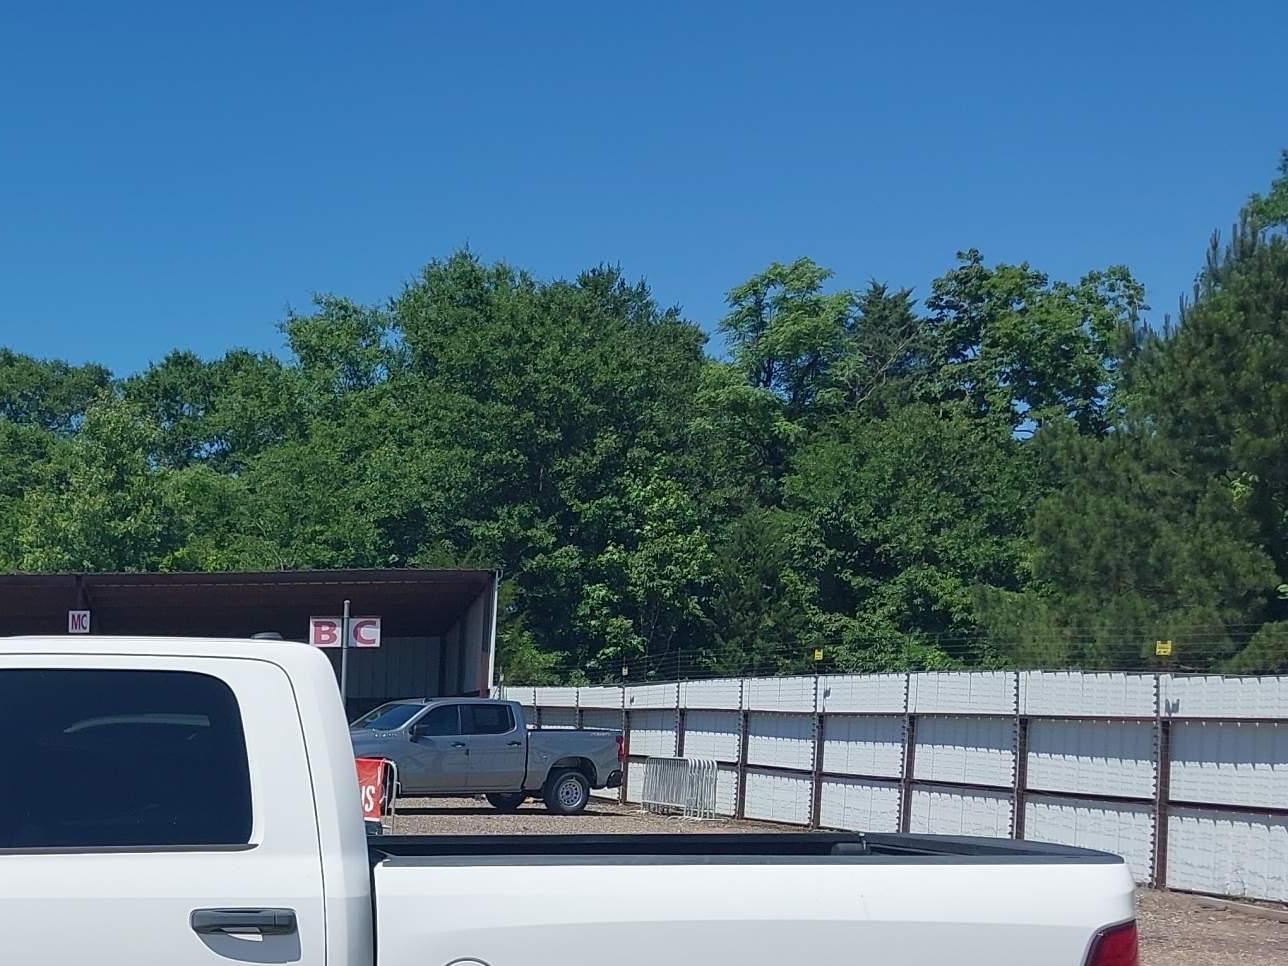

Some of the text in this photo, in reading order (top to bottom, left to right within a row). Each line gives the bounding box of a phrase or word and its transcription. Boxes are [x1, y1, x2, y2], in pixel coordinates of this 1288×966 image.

[72, 614, 88, 630] MC
[314, 621, 337, 644] B
[353, 620, 376, 645] C
